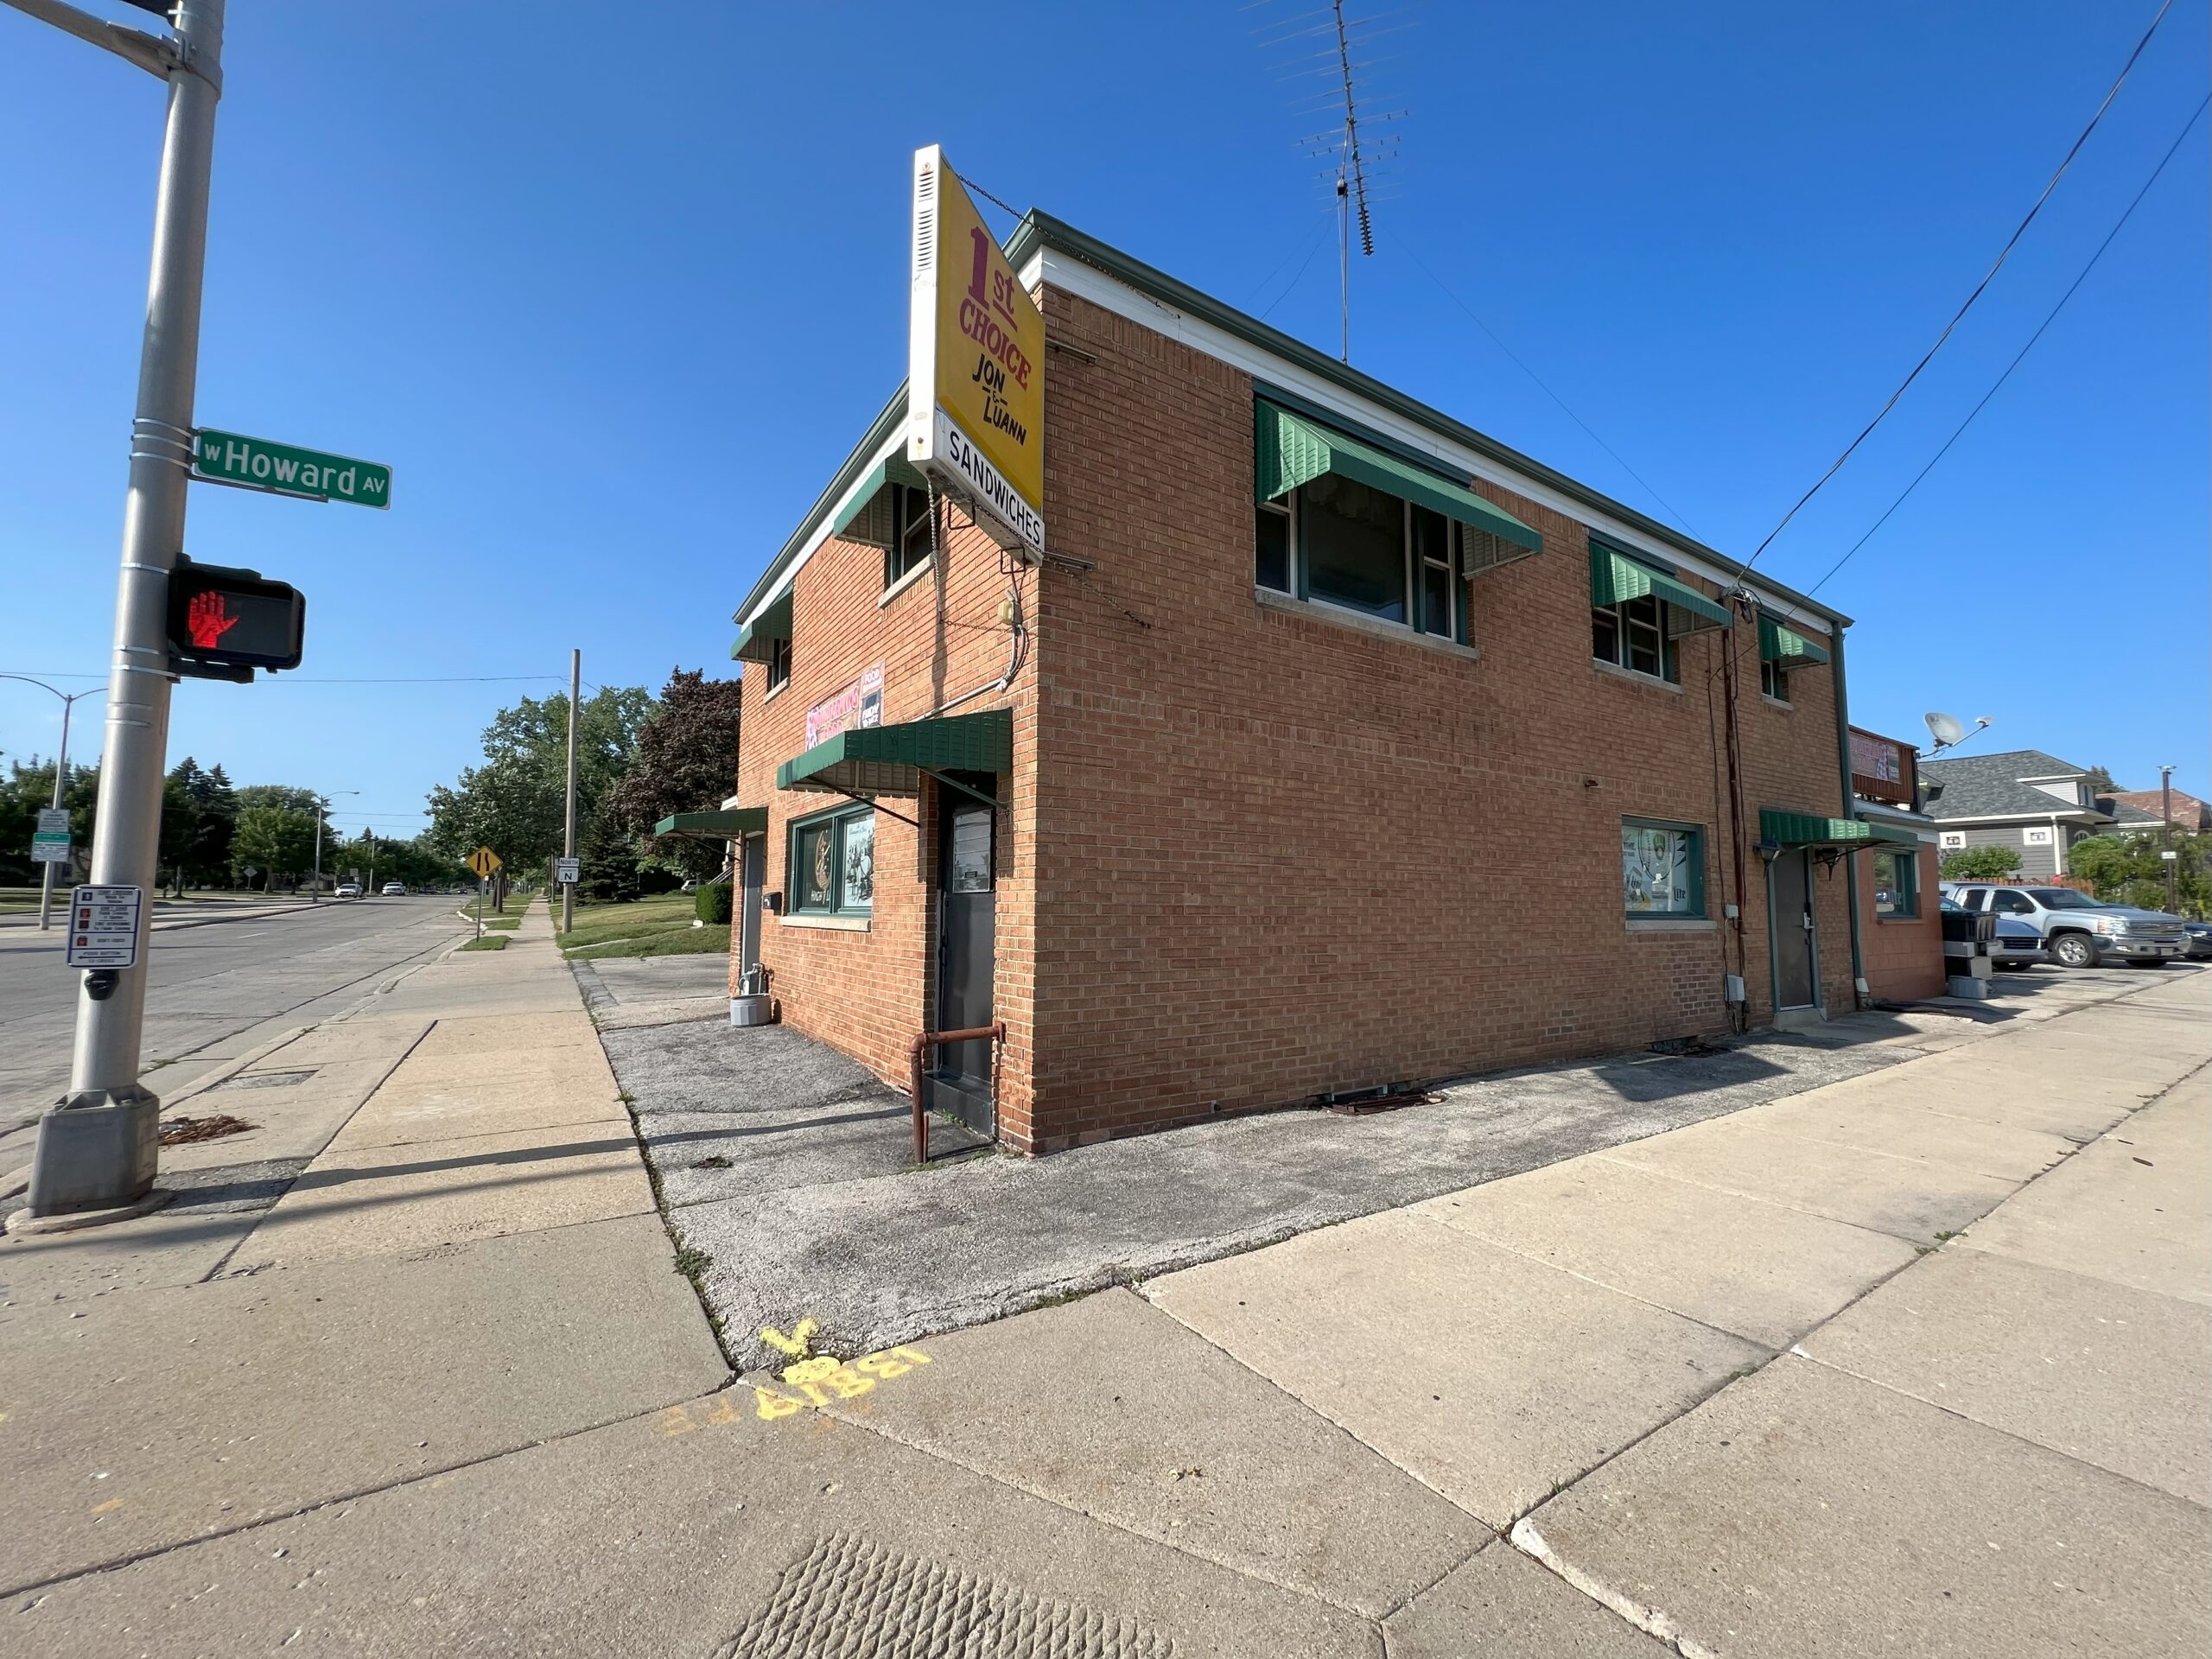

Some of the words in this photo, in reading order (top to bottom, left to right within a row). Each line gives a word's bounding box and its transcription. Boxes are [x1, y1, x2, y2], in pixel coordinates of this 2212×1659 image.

[968, 226, 1015, 315] 1st
[959, 297, 1032, 390] CHOICE
[972, 353, 1005, 393] JON
[982, 395, 1027, 446] LUANN
[204, 443, 221, 461] W
[225, 440, 356, 495] Howard
[363, 476, 385, 493] AV
[950, 430, 1040, 546] SANDWICHES
[1674, 887, 1686, 901] Lite
